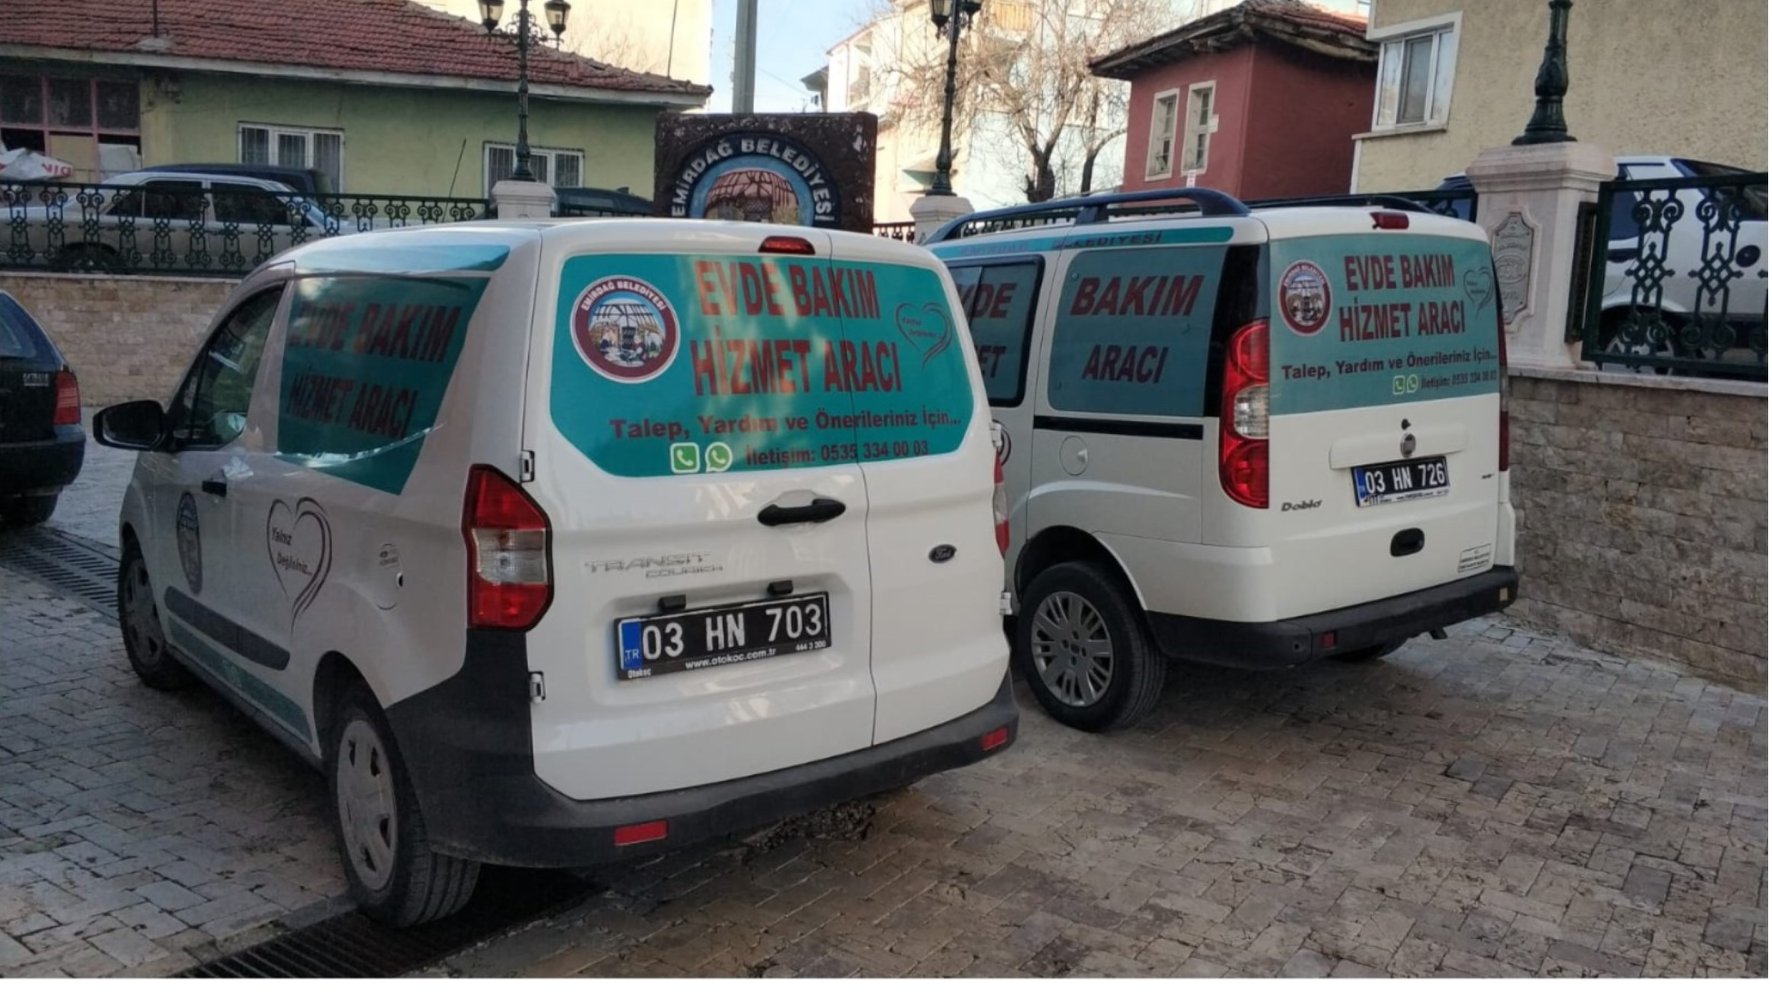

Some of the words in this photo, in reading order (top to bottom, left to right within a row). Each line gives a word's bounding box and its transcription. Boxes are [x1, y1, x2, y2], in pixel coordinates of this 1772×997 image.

[671, 139, 733, 217] EMİRDAĞ
[740, 138, 835, 221] BELEDİYESİ
[694, 261, 785, 316] EVDE
[789, 263, 880, 319] BAKIM
[1344, 254, 1397, 291] EVDE
[1400, 254, 1455, 289] BAKIM
[1070, 275, 1205, 316] BAKIM
[355, 302, 462, 362] BAKIM
[1338, 297, 1411, 342] HİZMET
[1417, 300, 1466, 335] ARACI
[689, 325, 810, 396] HİZMET
[824, 340, 902, 392] ARACI
[1082, 344, 1169, 383] ARACI
[1281, 363, 1330, 380] Talep,
[1336, 358, 1385, 375] Yardım
[1388, 357, 1403, 369] ve
[1407, 349, 1471, 367] Önerileriniz
[610, 417, 690, 441] Talep,
[697, 414, 777, 435] Yardım
[785, 416, 808, 430] ve
[815, 407, 917, 431] Önerileriniz
[746, 443, 817, 469] İletişim:
[821, 443, 857, 461] 0535
[863, 441, 888, 459] 334
[893, 440, 909, 457] 00
[913, 439, 929, 456] 03
[1364, 471, 1386, 494] 03
[1392, 466, 1413, 491] HN
[1418, 463, 1446, 487] 726
[642, 622, 684, 660] 03
[705, 612, 746, 652] HN
[765, 603, 822, 643] 703
[625, 648, 640, 660] TR
[684, 646, 777, 670] www.otokoc.com.tr
